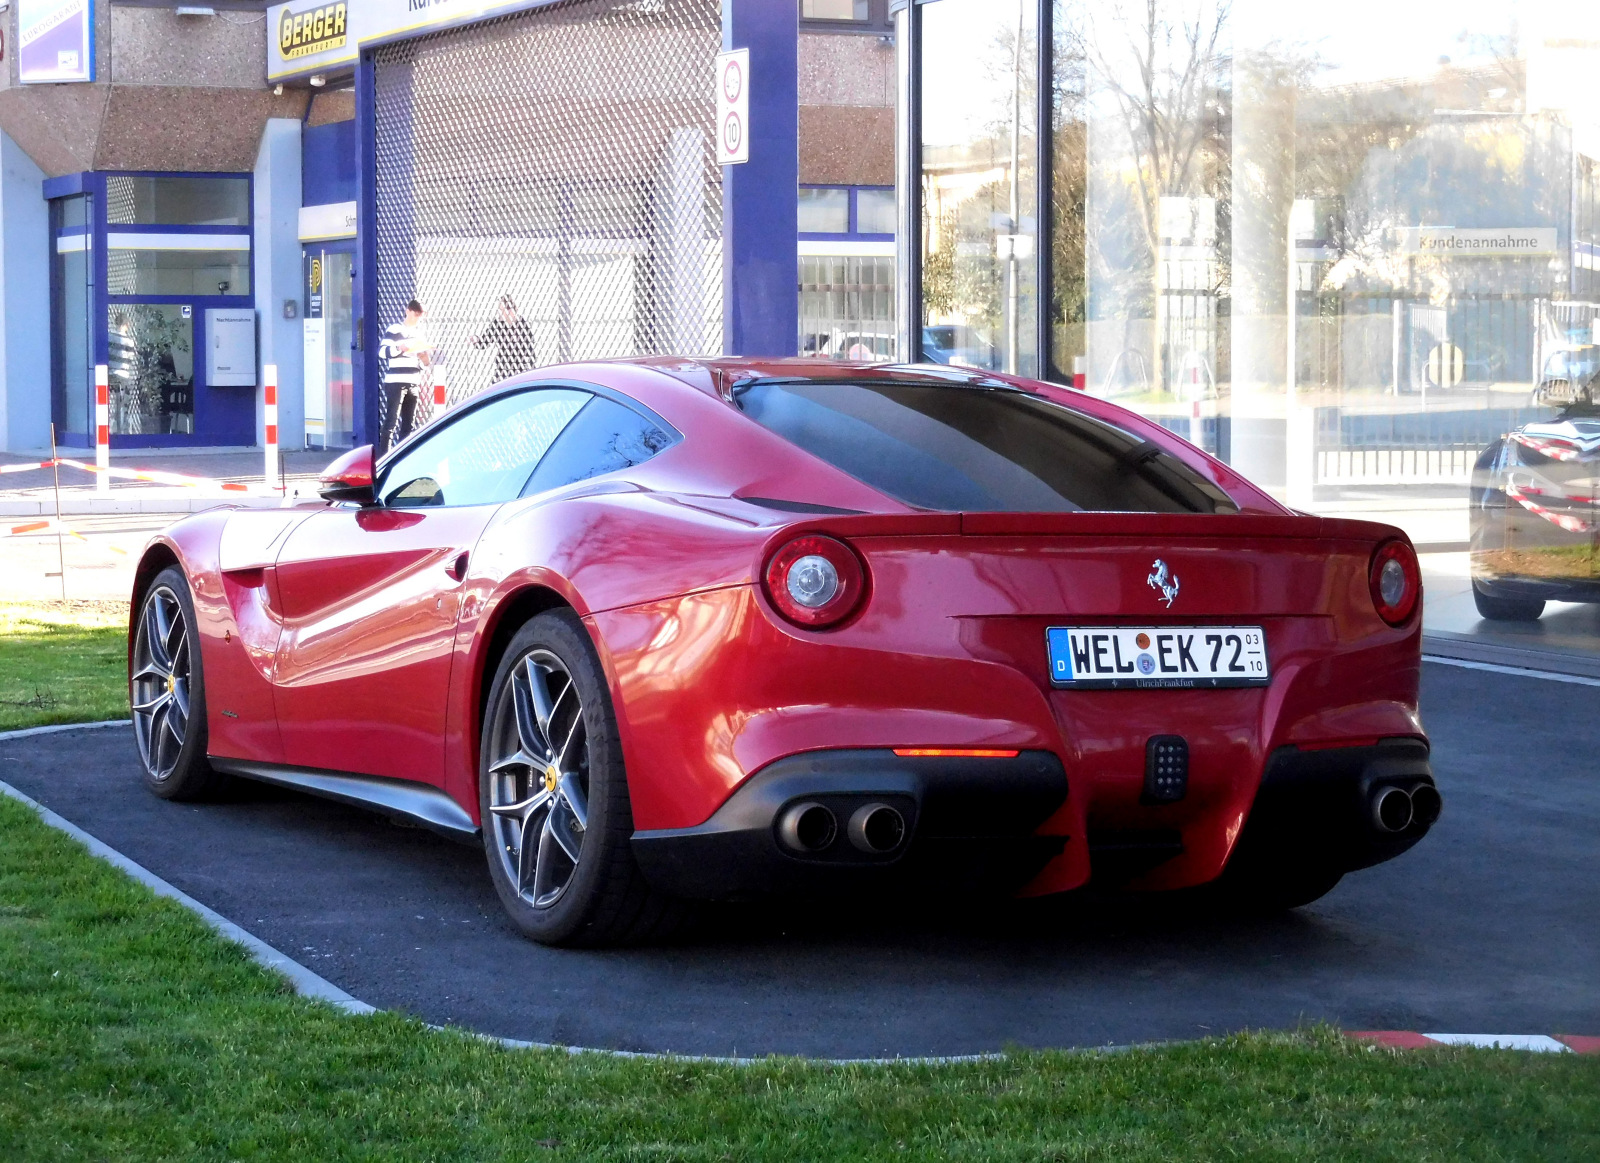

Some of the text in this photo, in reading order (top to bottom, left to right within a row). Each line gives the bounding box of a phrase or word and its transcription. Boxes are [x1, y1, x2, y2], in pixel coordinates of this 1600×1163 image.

[282, 3, 346, 48] BERGER
[728, 122, 737, 143] 10
[1419, 235, 1538, 249] Kundenannahme
[1245, 634, 1259, 645] 03
[1071, 634, 1246, 673] WEL EK 72
[1057, 660, 1065, 671] D
[1250, 660, 1263, 671] 10
